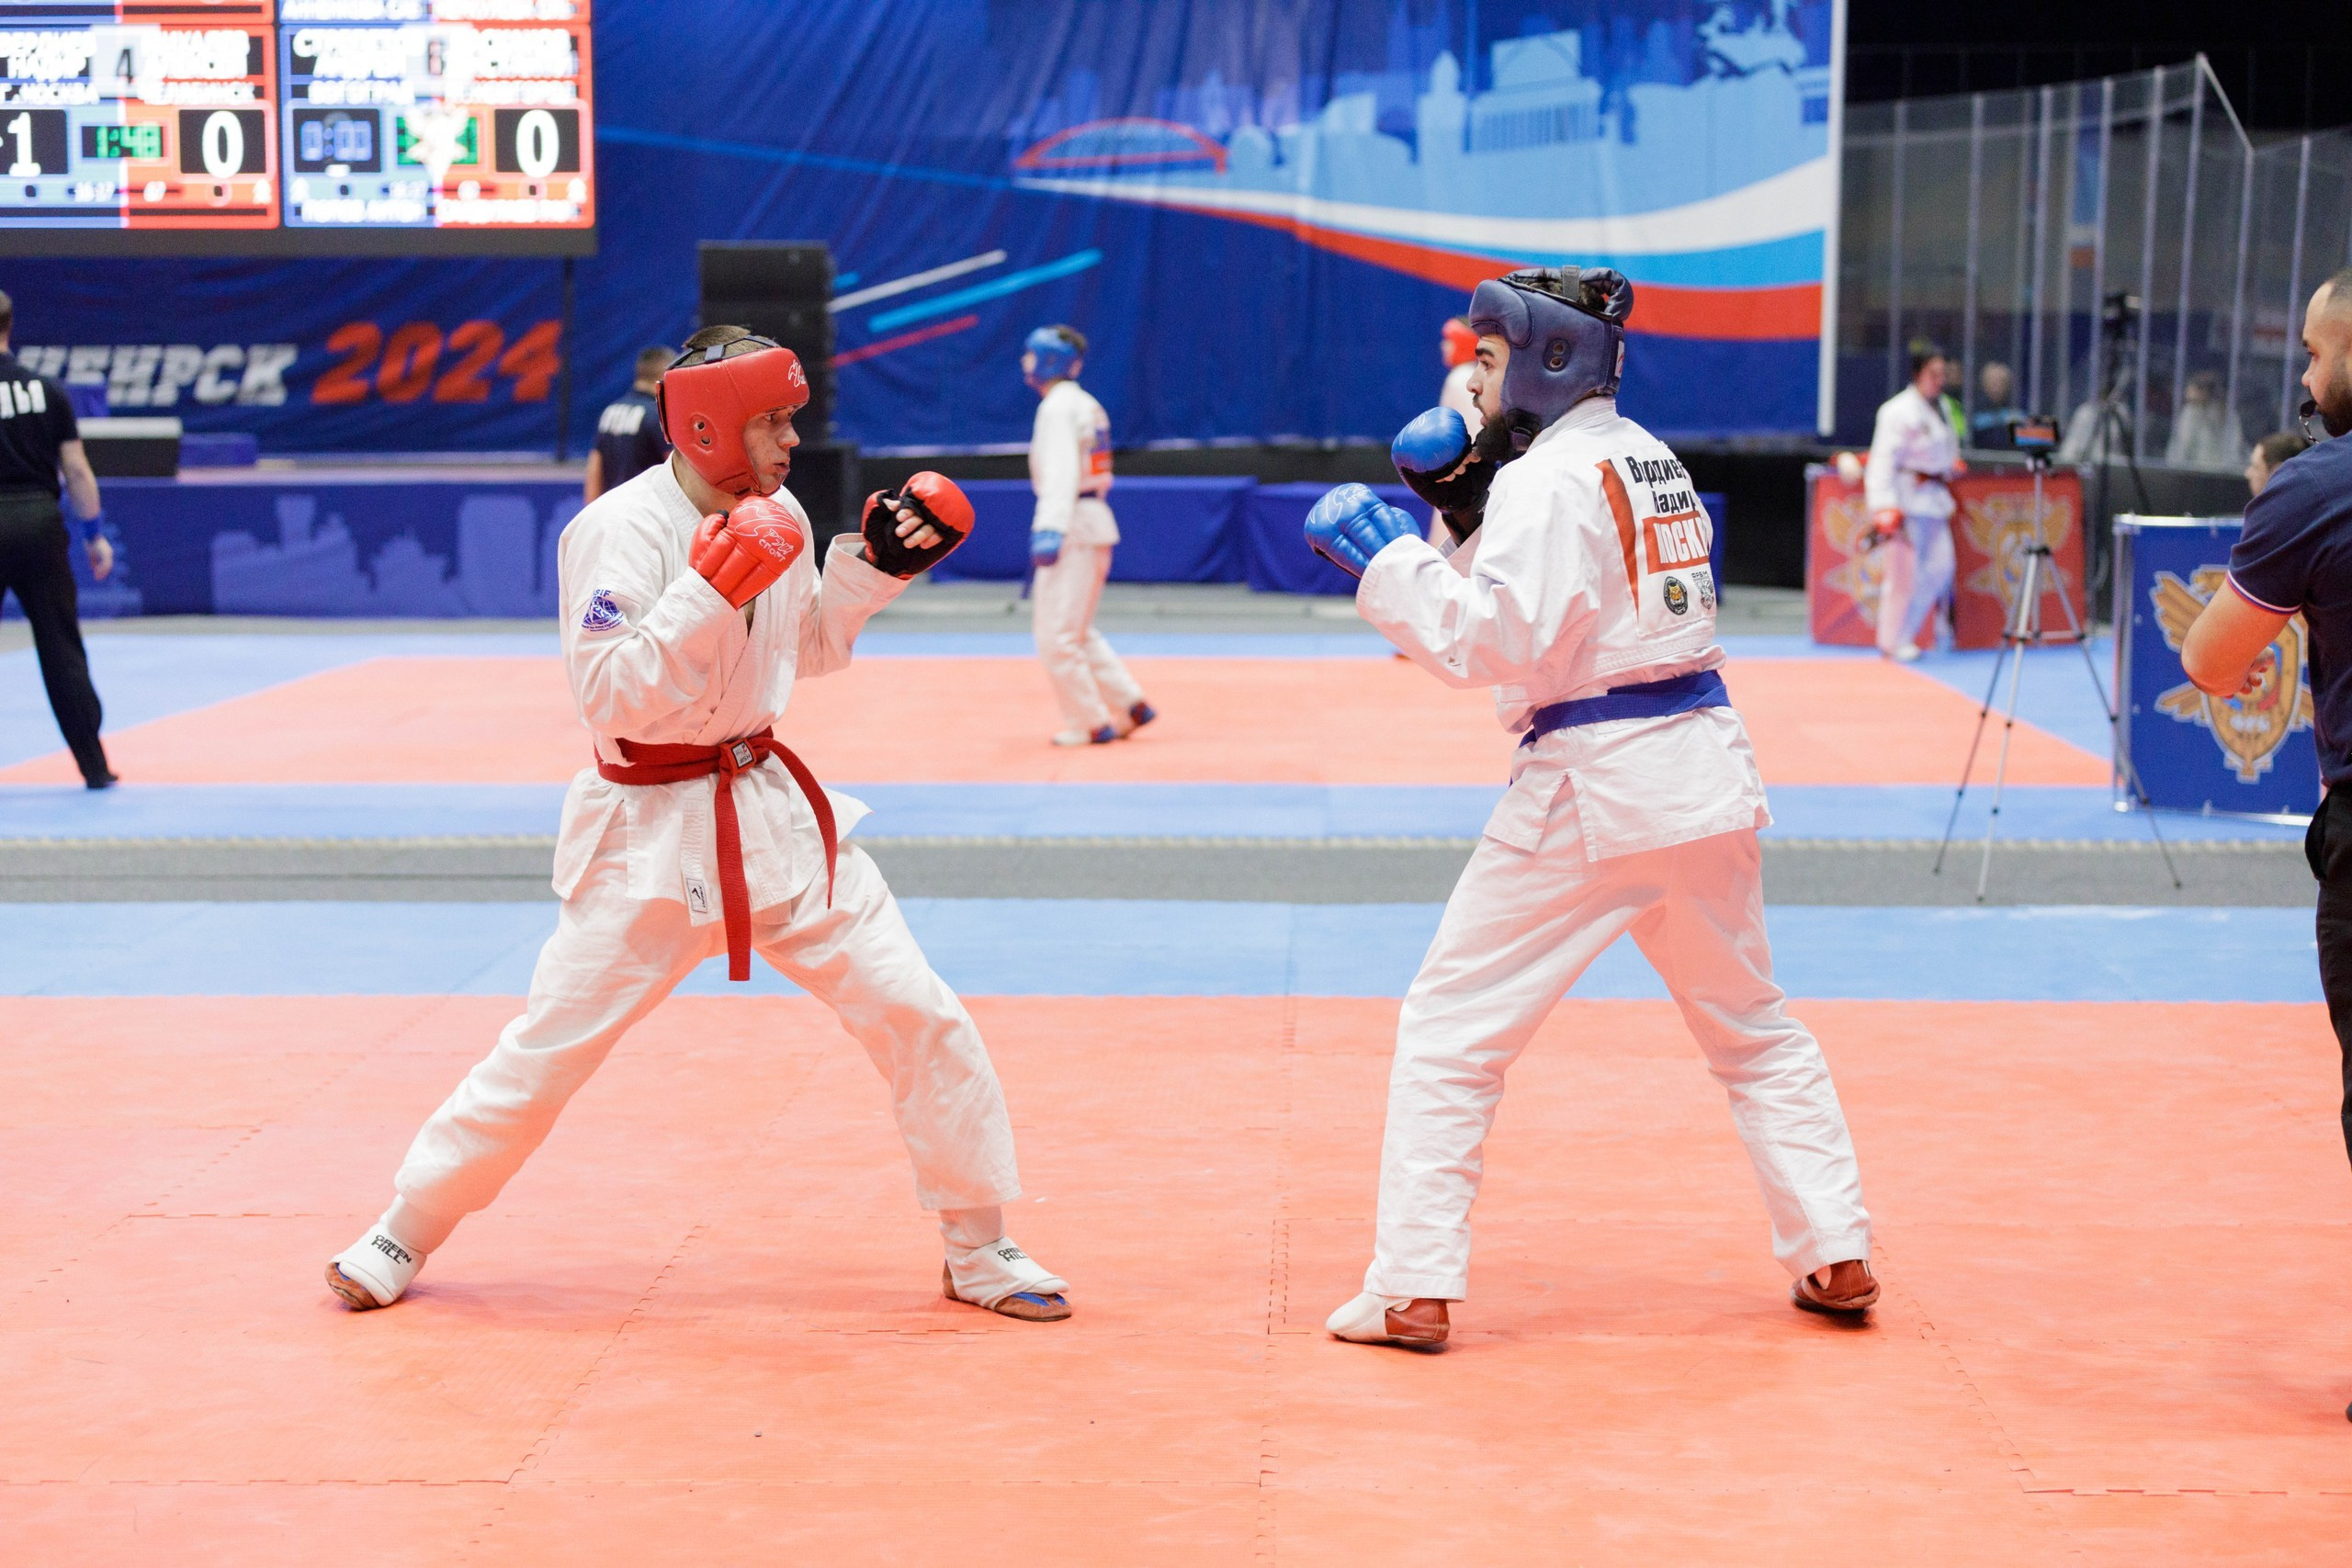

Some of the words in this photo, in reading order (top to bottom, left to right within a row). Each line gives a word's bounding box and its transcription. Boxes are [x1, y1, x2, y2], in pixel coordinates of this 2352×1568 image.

[0, 111, 41, 177] 1
[202, 110, 244, 178] 0
[515, 109, 560, 178] 0
[311, 321, 562, 403] 2024
[1624, 456, 1687, 488] Врдие
[1652, 491, 1696, 513] ади
[759, 538, 786, 562] СПОРТ
[371, 1239, 401, 1264] HILL
[376, 1235, 412, 1264] GREEN
